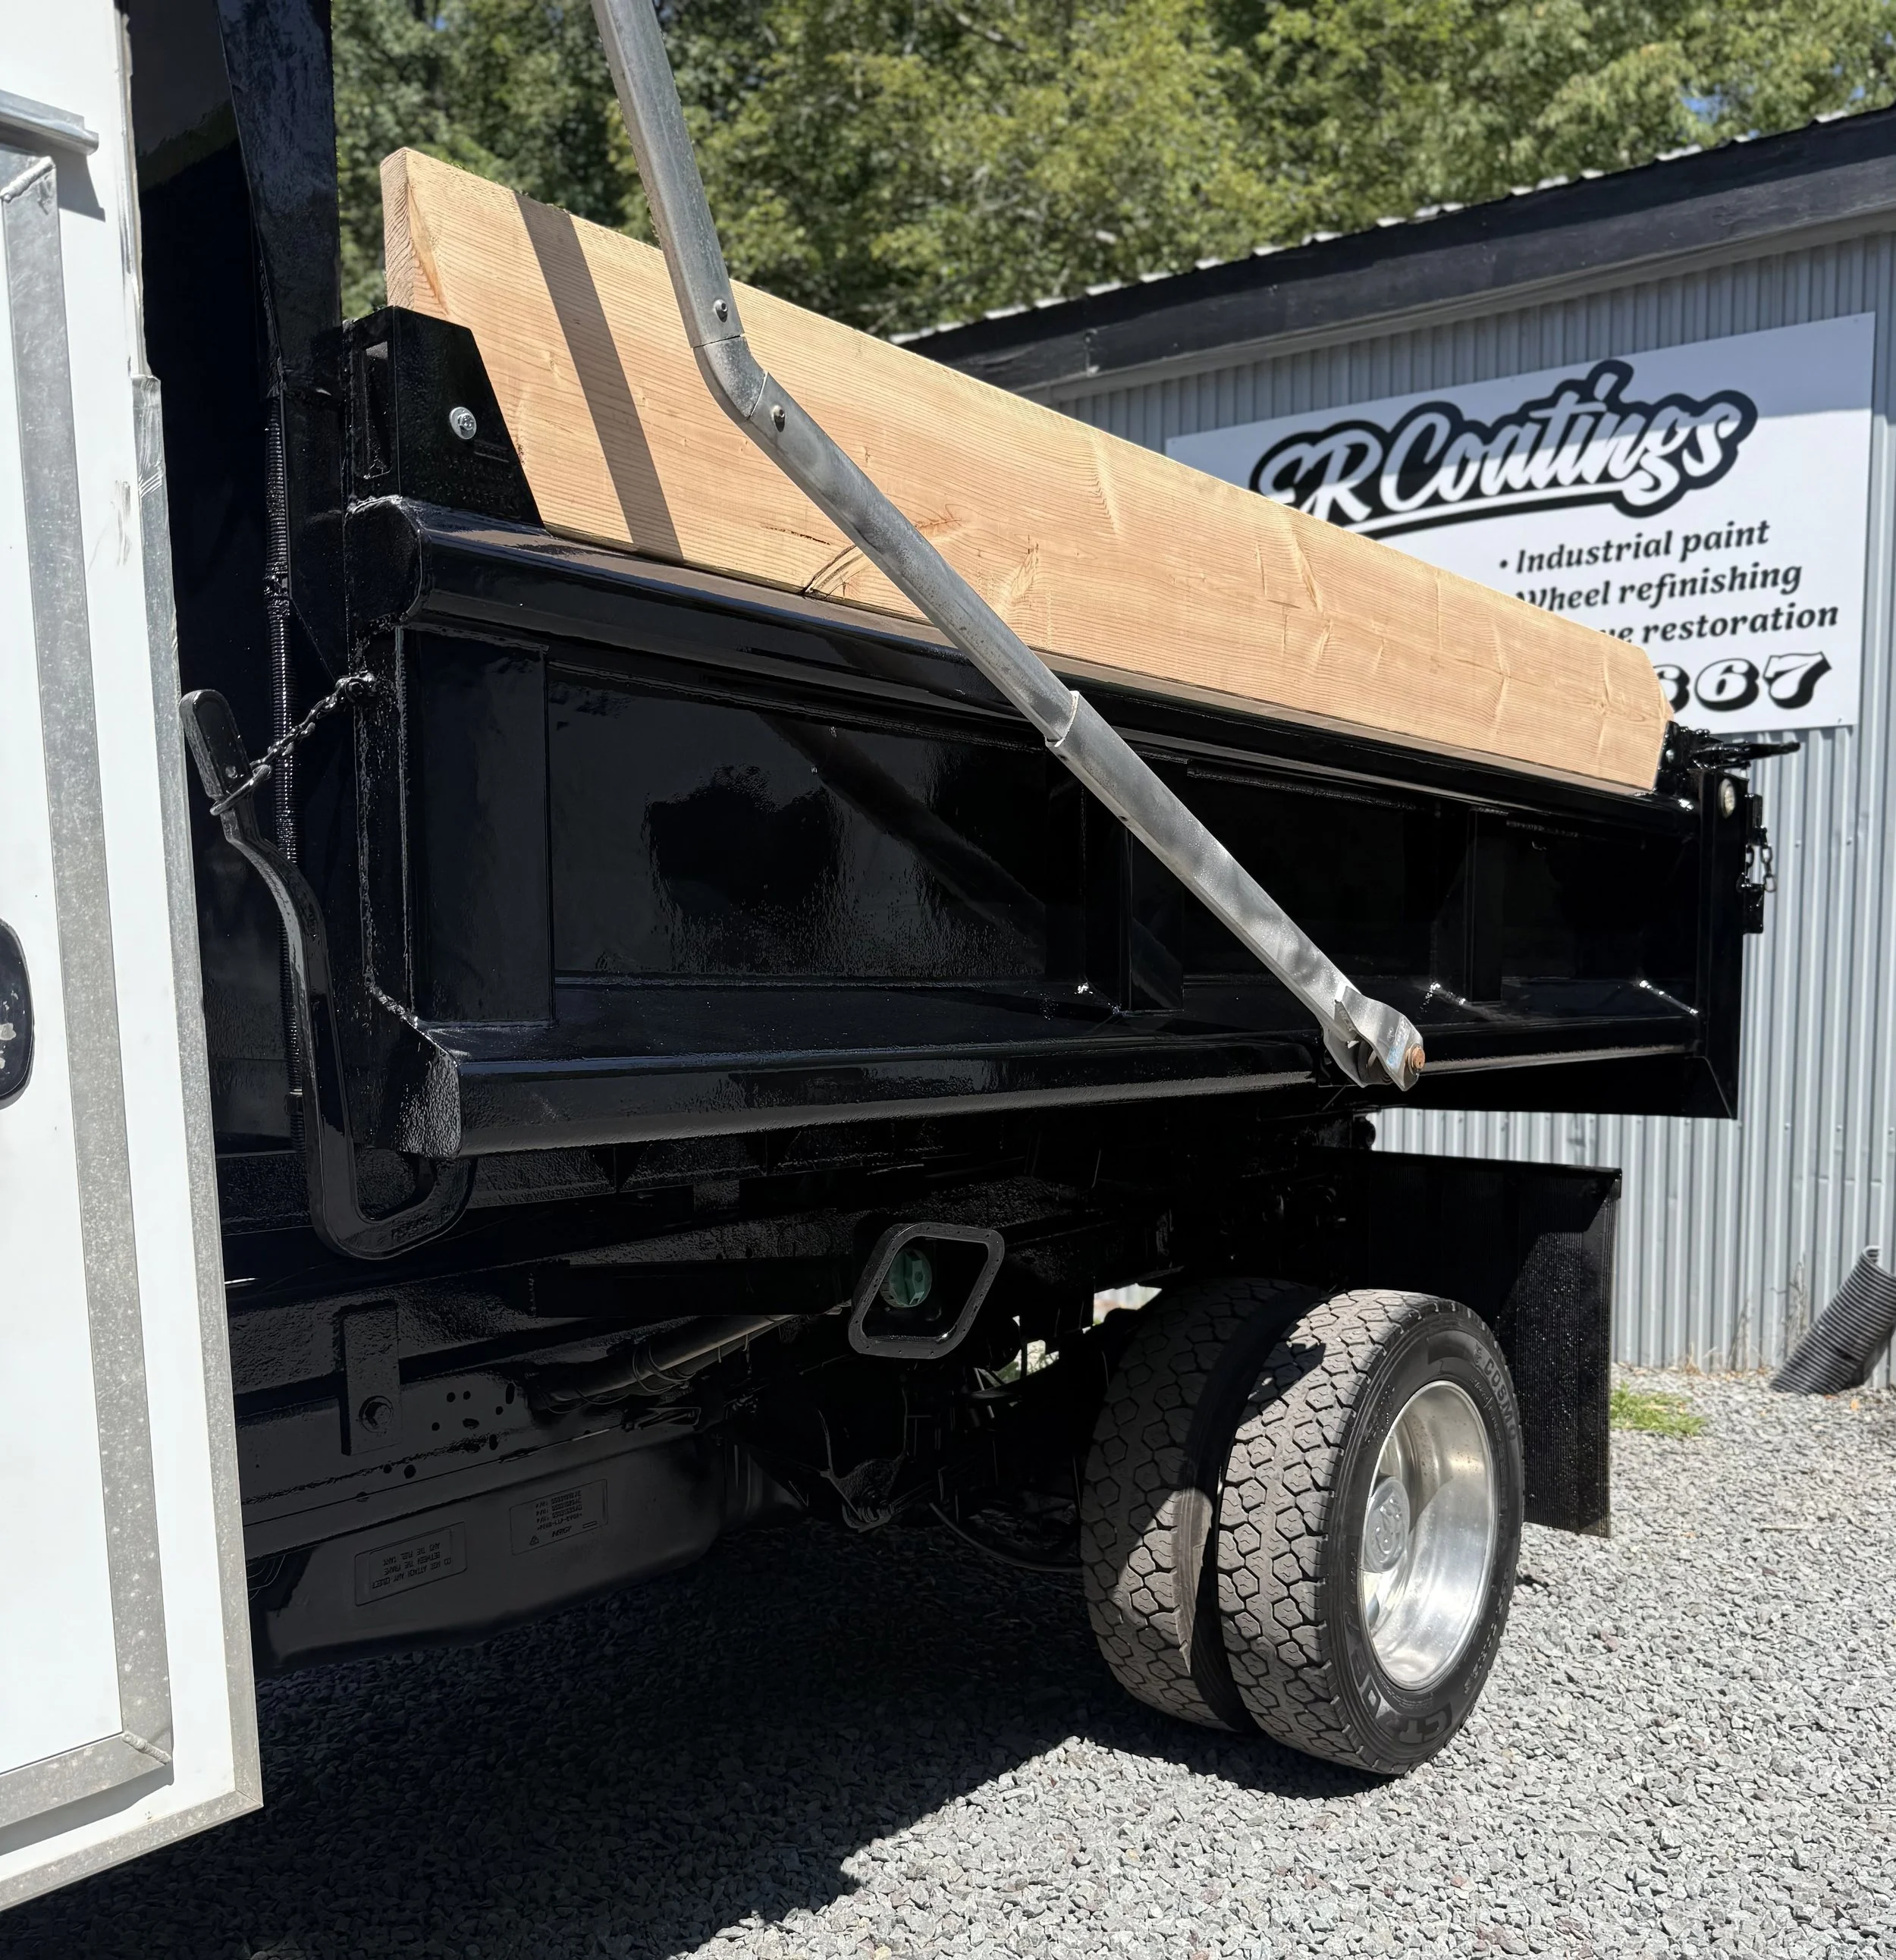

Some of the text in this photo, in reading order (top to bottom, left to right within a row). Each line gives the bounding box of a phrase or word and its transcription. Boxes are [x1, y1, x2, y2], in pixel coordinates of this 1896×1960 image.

[1377, 360, 1756, 517] Coatings
[1516, 520, 1770, 574] Industrial paint
[1618, 562, 1802, 609] refinishing
[1642, 602, 1838, 643] restoration
[1483, 1355, 1518, 1441] COSMO
